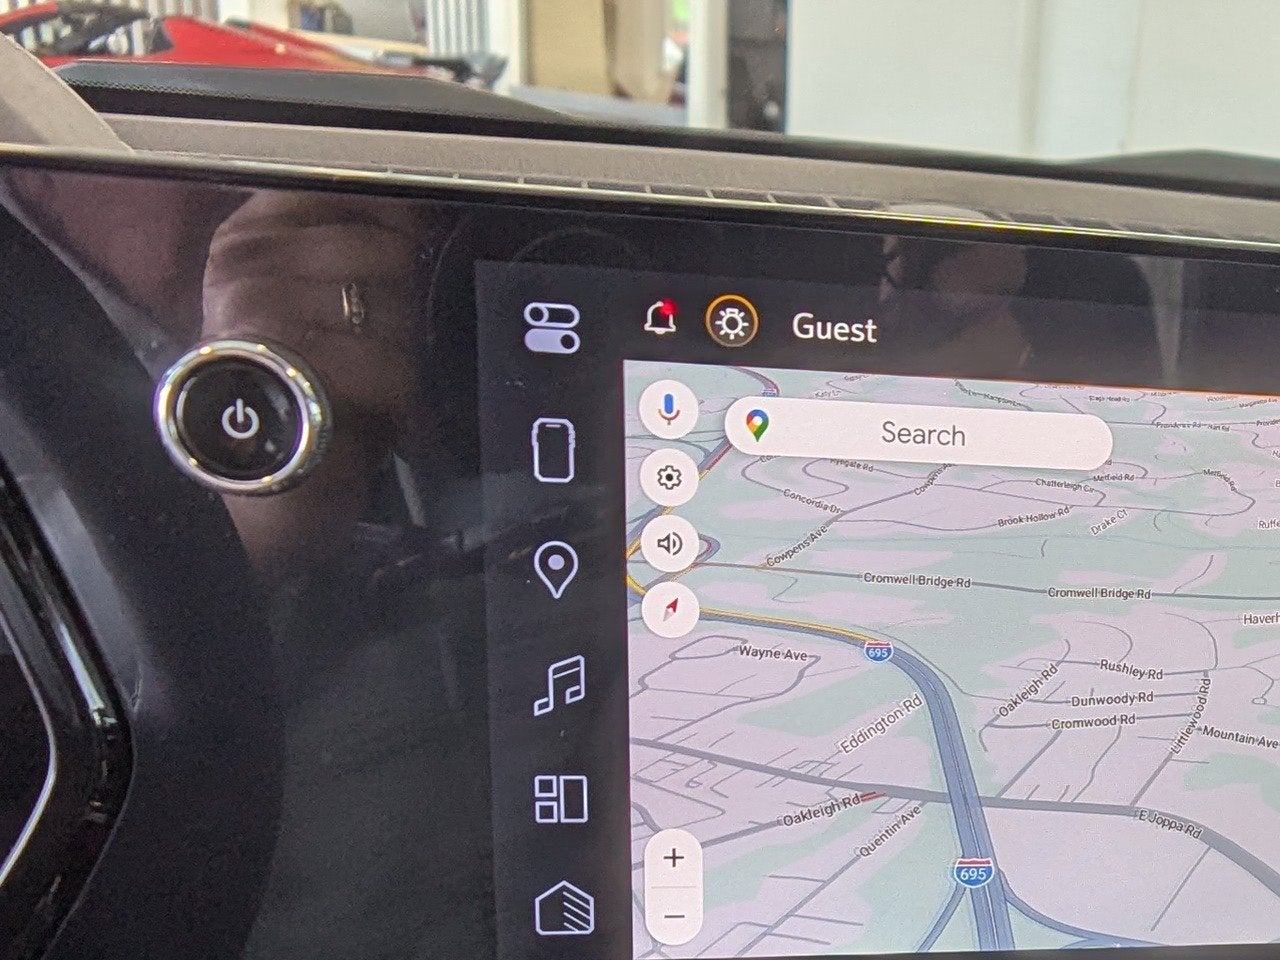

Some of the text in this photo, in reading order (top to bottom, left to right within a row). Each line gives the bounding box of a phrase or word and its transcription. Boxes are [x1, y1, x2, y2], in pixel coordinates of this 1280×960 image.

[793, 312, 877, 343] Guest
[881, 420, 966, 446] Search
[862, 464, 874, 472] Rd
[783, 488, 841, 514] Concordia Dr
[998, 506, 1070, 528] Brook Hollow Rd
[1091, 509, 1128, 536] Drake Ct
[766, 524, 828, 567] Cowpens Ave
[864, 572, 971, 589] Cromwell Bridge Rd
[1048, 587, 1151, 600] Cromwell Bridge Rd
[739, 646, 808, 662] Wayne Ave
[868, 647, 889, 658] 695
[1100, 659, 1164, 680] Rushley Rd
[999, 663, 1058, 718] Oakleigh Rd
[1071, 692, 1154, 707] Dunwoody Rd
[840, 693, 924, 754] Eddington Rd
[1051, 714, 1136, 730] Cromwood Rd
[1171, 678, 1212, 755] Littlewood Rd
[1202, 726, 1278, 750] Mountain Ave
[782, 792, 861, 828] Oakleigh Rd
[859, 804, 922, 858] Quentin Ave
[1138, 810, 1202, 840] E Joppa Rd
[960, 868, 988, 881] 695
